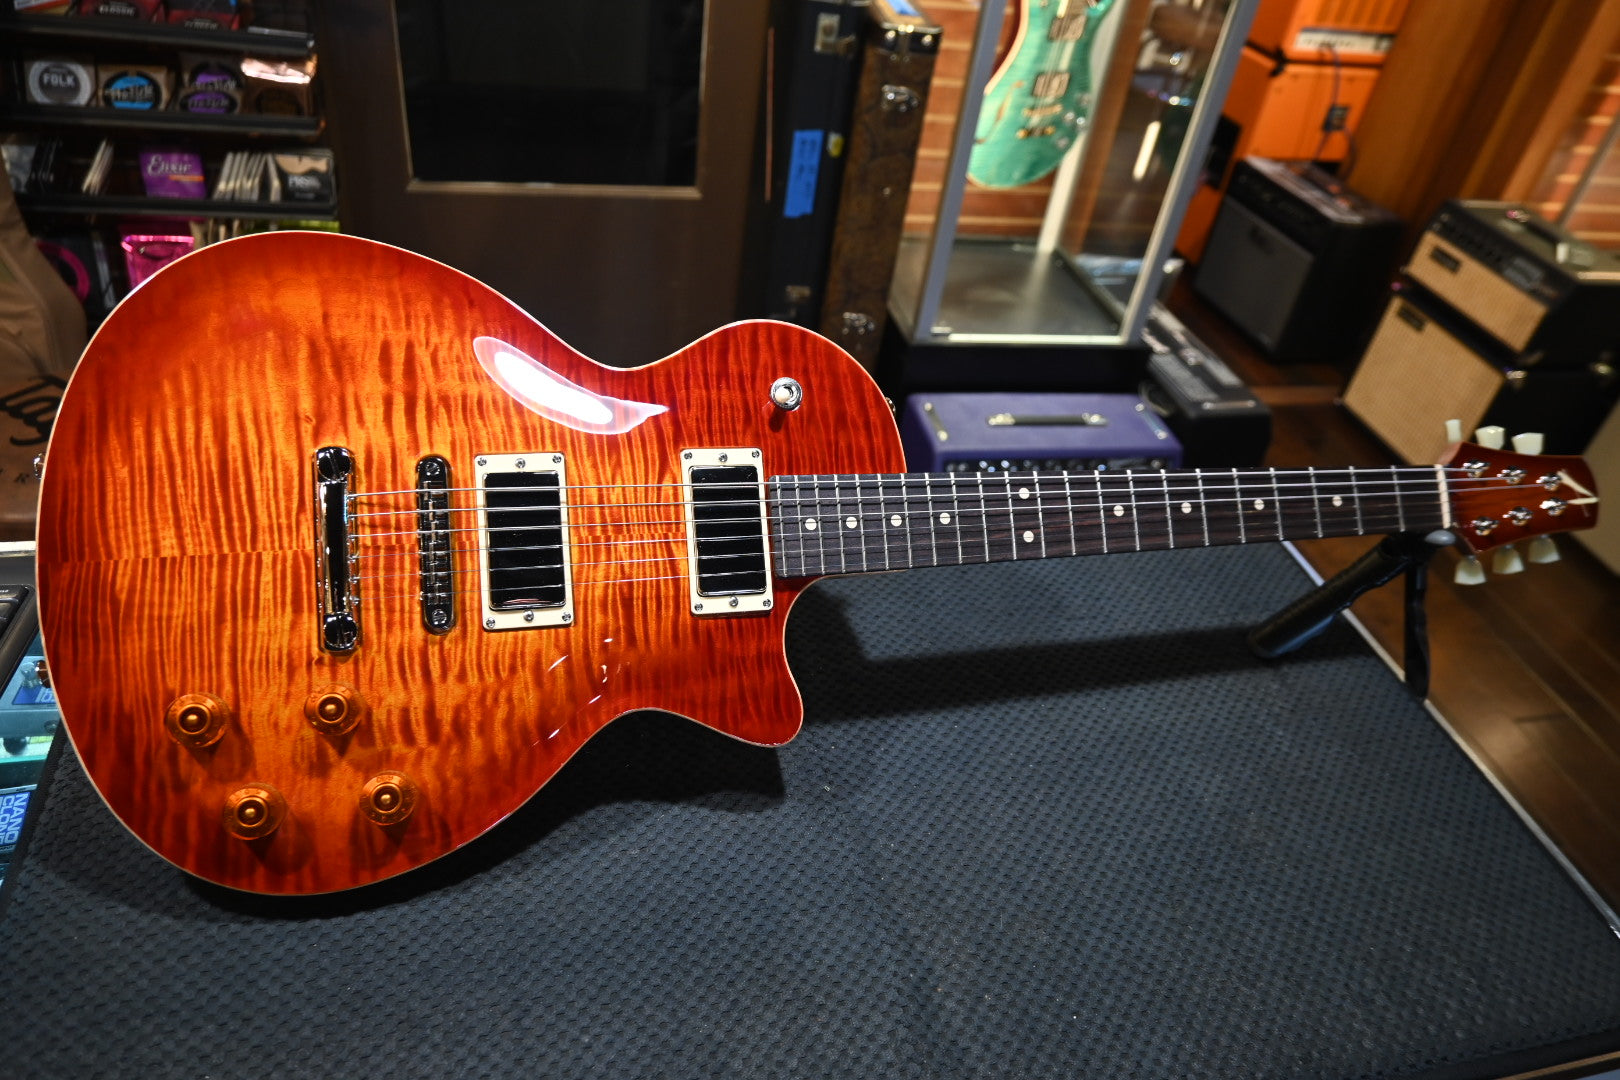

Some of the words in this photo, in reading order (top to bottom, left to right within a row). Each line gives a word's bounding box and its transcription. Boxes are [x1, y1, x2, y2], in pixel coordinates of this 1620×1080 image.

[43, 73, 75, 87] FOLK
[147, 154, 193, 178] Elixir
[4, 794, 30, 843] NANO
